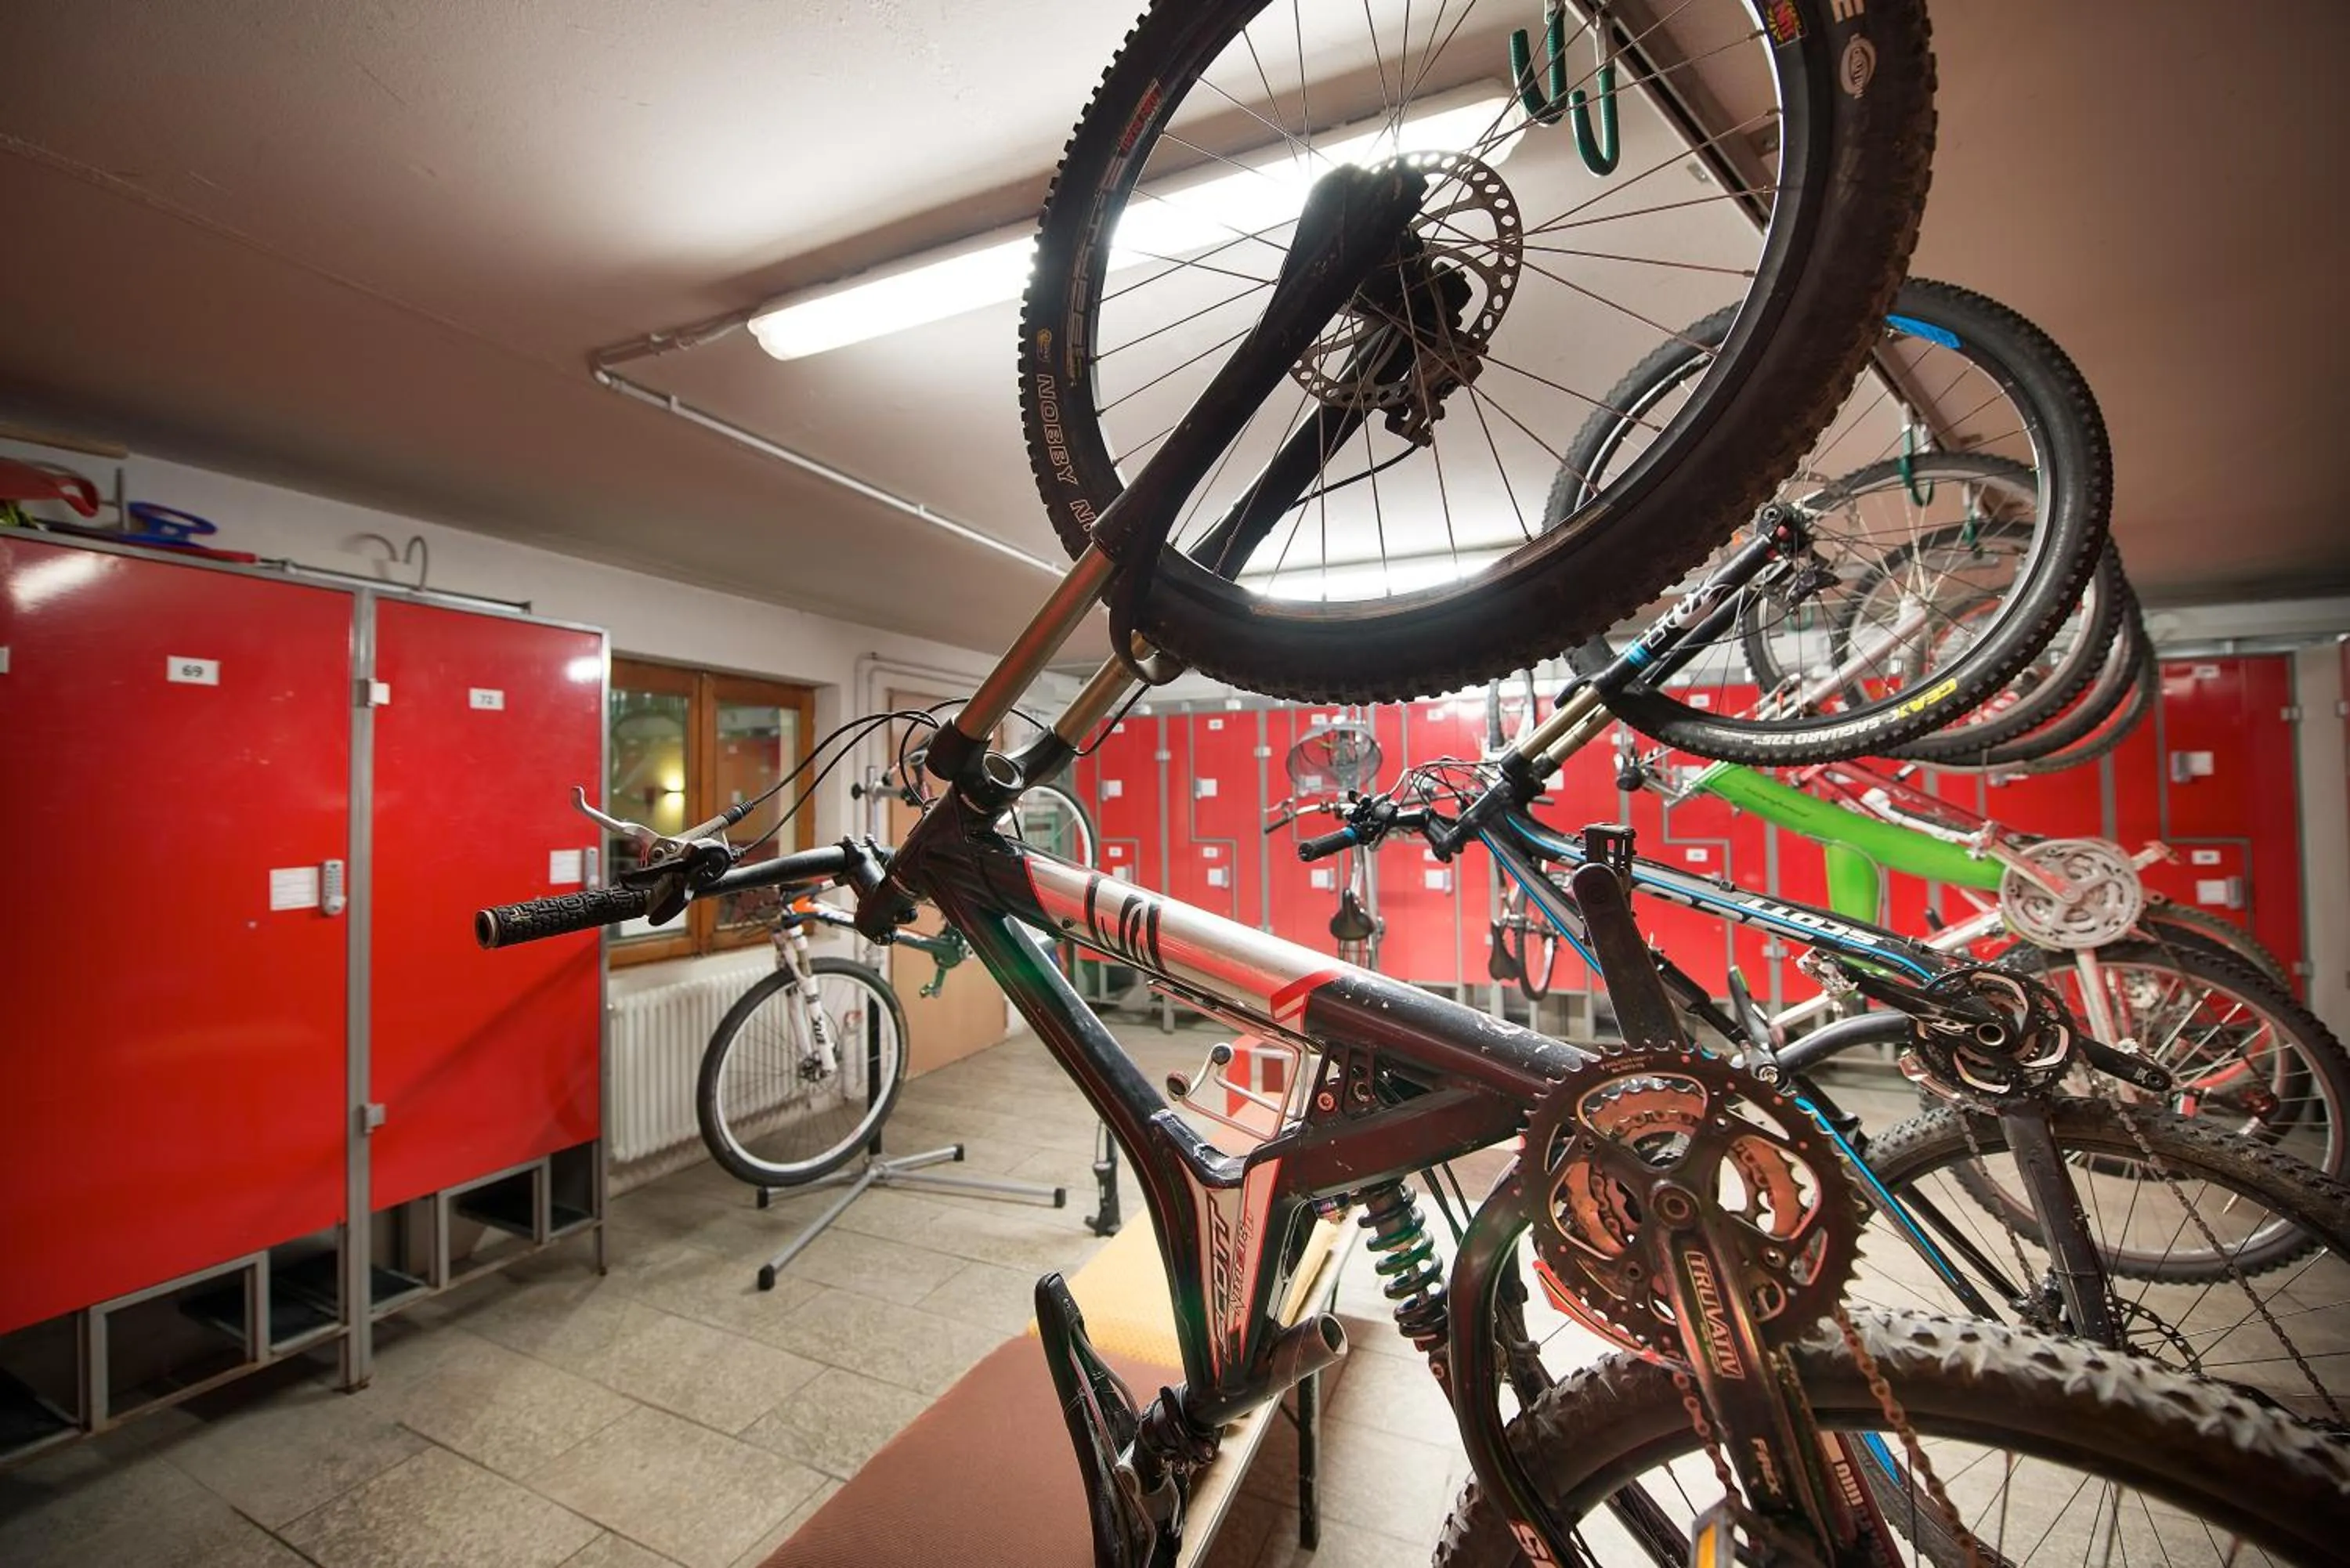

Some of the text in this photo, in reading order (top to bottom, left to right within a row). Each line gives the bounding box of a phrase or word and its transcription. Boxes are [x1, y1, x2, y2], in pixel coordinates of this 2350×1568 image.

[1036, 374, 1078, 486] NOBBY
[182, 664, 204, 678] 69
[1737, 897, 1884, 946] SCOTT
[1206, 1189, 1232, 1364] SCOTT
[1687, 1255, 1744, 1376] TRUVATIV
